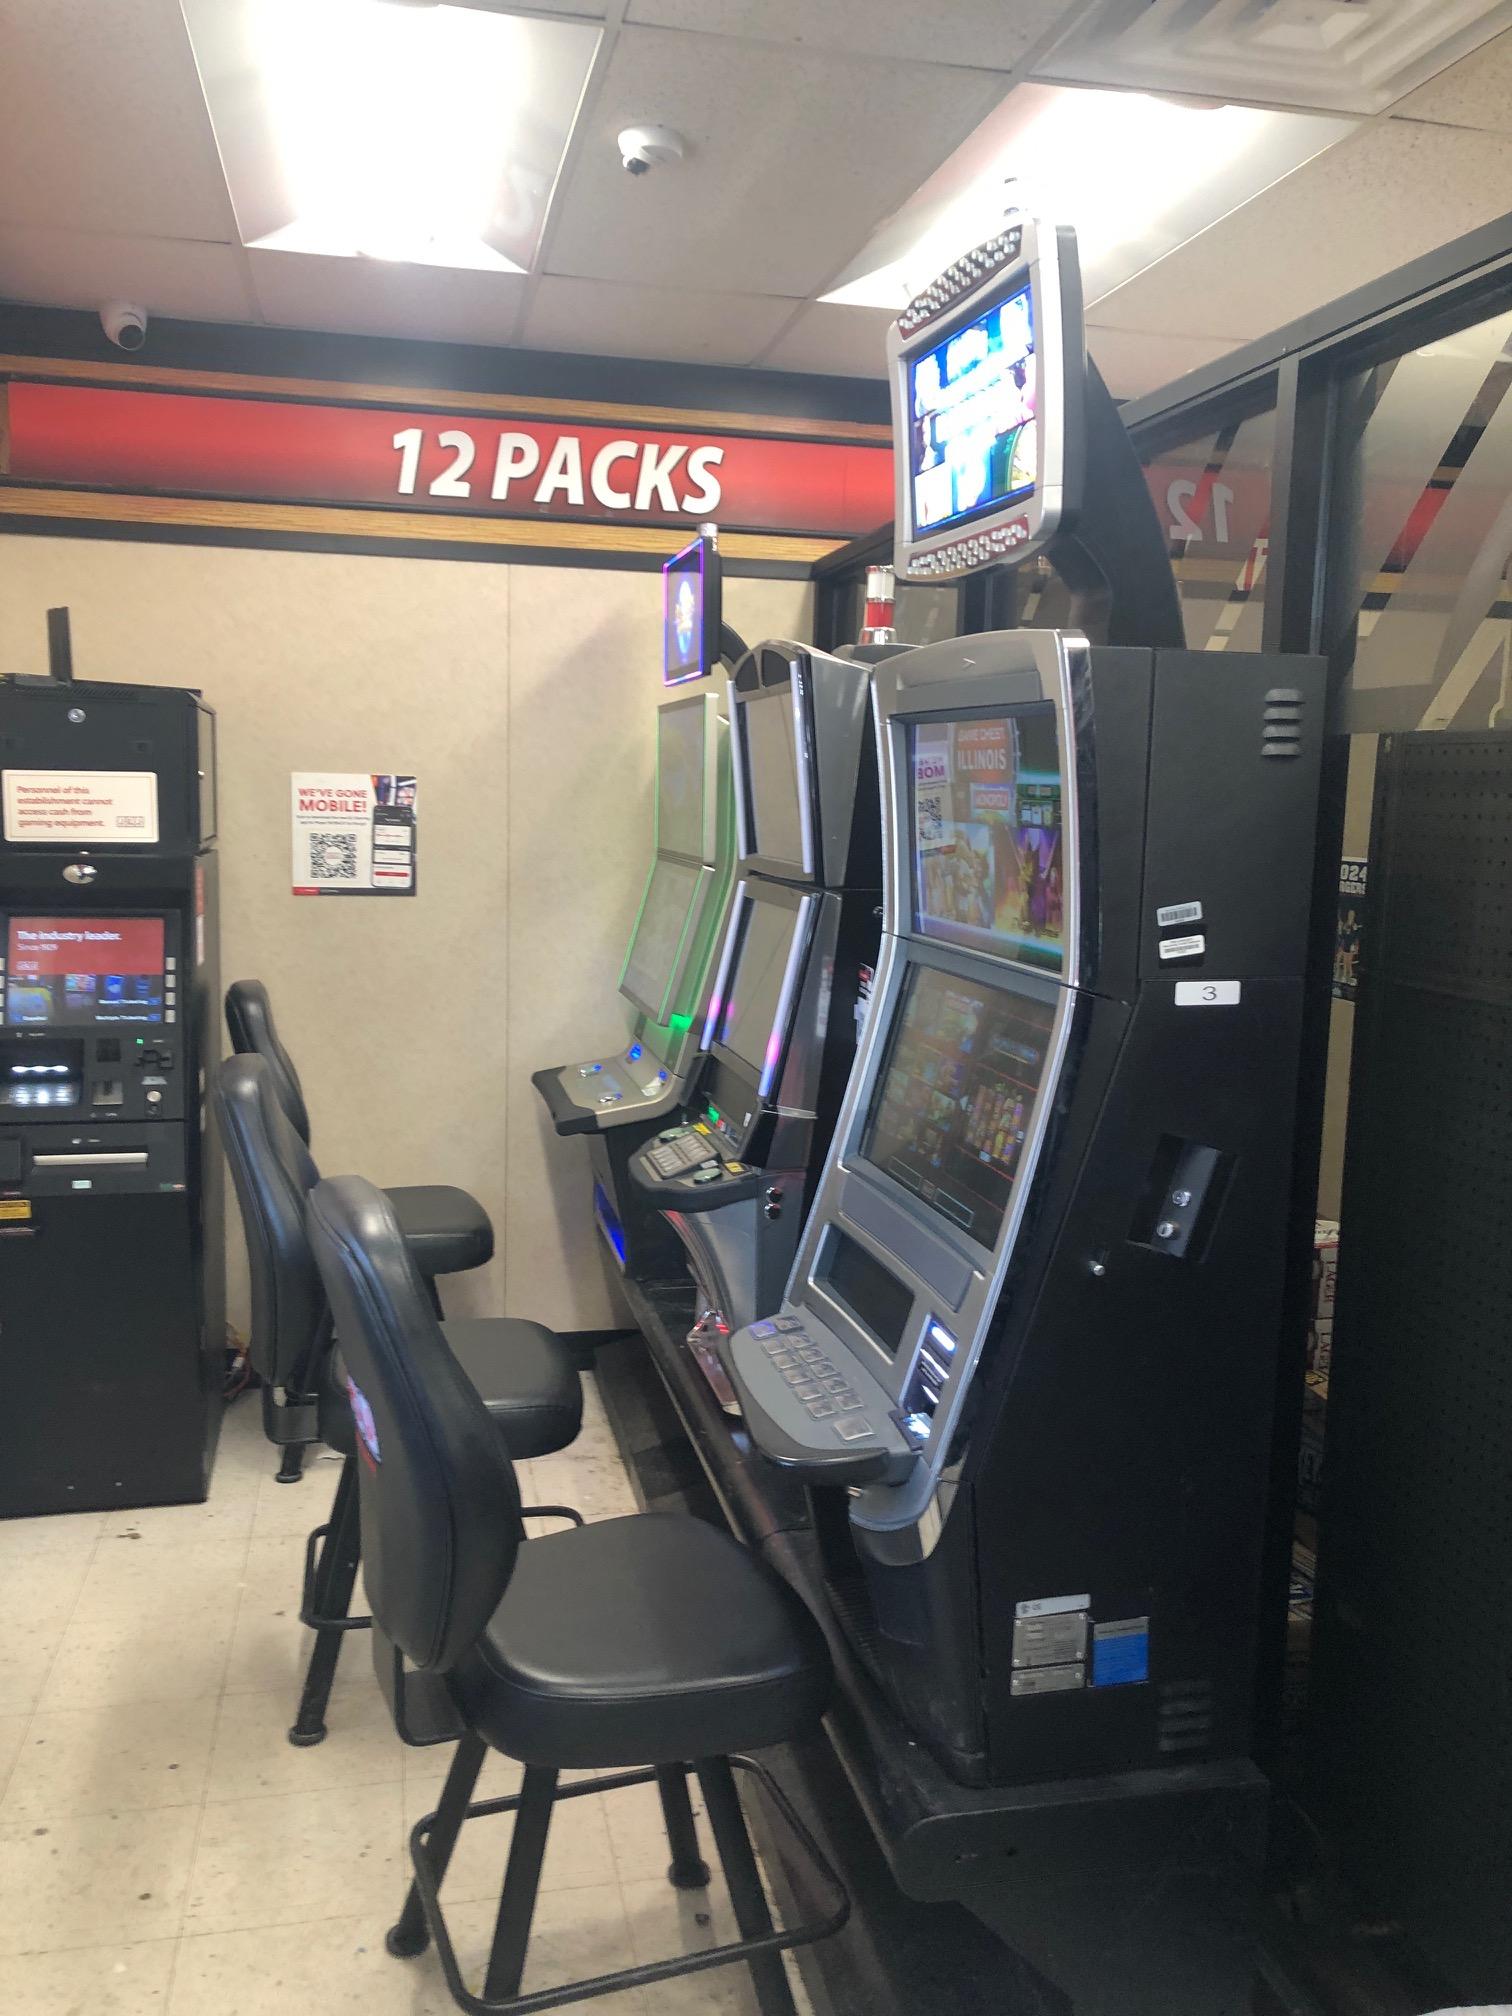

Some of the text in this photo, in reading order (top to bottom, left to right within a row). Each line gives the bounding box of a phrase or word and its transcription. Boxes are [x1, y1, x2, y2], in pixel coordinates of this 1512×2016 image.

[393, 428, 725, 515] 12 PACKS
[957, 748, 1006, 770] ILLINOIS
[298, 788, 367, 798] WE'VE GONE
[299, 799, 367, 812] MOBILE!
[17, 931, 38, 940] The
[1202, 986, 1217, 1001] 3
